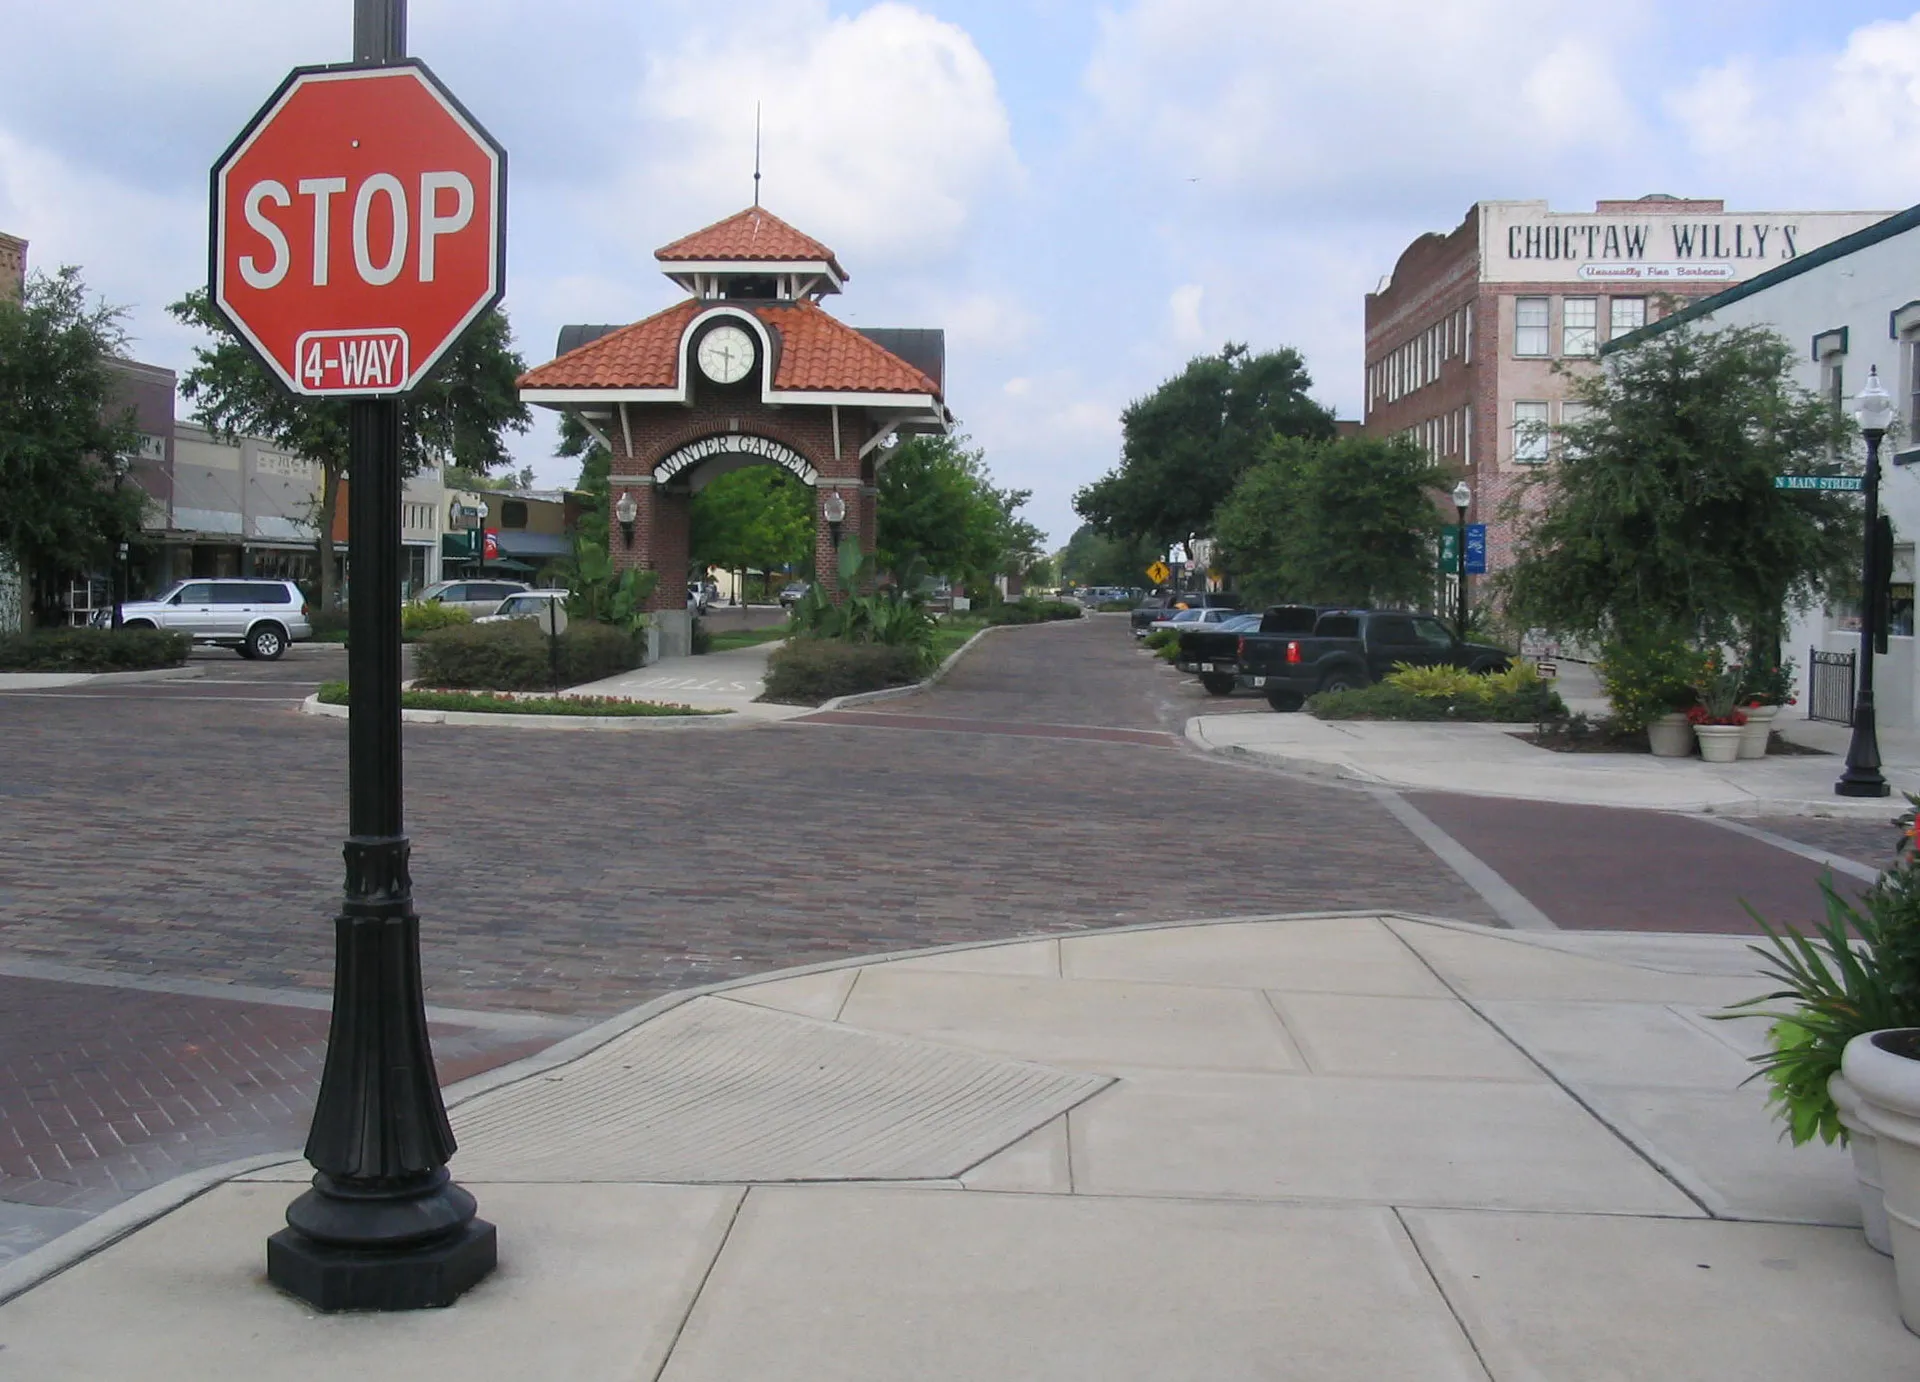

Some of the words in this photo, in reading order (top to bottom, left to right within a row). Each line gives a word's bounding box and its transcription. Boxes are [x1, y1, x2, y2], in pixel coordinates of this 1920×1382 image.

[238, 170, 475, 290] STOP
[1508, 224, 1649, 260] CHOCTAW
[1672, 224, 1799, 260] WILLY'S
[1586, 266, 1642, 278] Unusually
[1647, 266, 1670, 277] Fine
[1676, 266, 1727, 277] Barbecue
[304, 338, 399, 387] 4-WAY
[660, 436, 729, 477] WINTER
[737, 435, 813, 481] GARDEN
[1775, 476, 1785, 489] N
[1787, 476, 1818, 489] MAIN
[1819, 477, 1862, 490] STREET
